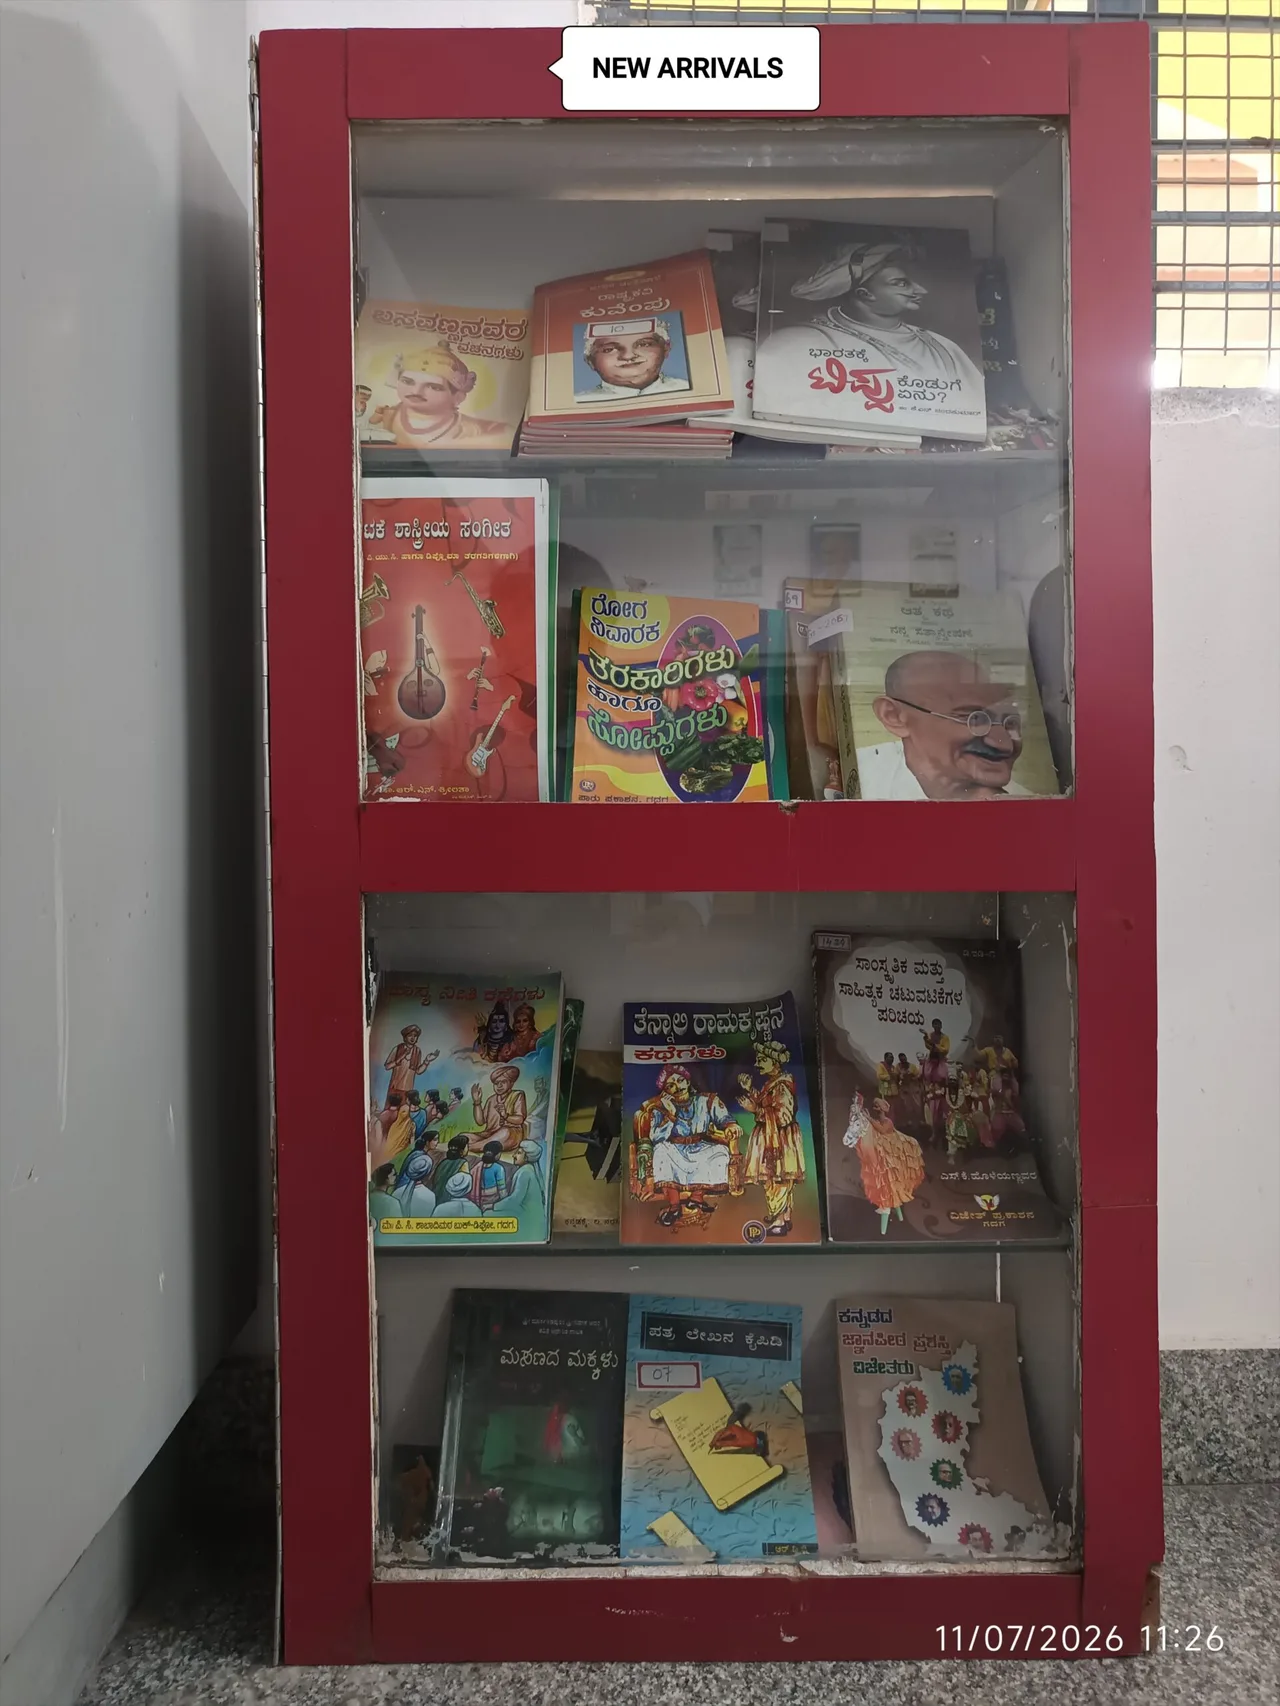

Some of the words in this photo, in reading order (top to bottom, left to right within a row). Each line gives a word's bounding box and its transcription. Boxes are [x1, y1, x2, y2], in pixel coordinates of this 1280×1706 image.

[581, 297, 670, 317] ಕುವೆಂಪು
[372, 309, 528, 344] ಬಸವಣ್ಣನವರ
[457, 341, 524, 361] ವಚನಗಳು
[808, 348, 869, 362] ಭಾರತಕ್ಕೆ
[808, 357, 897, 413] ಟಿಪ್ಪು
[897, 375, 962, 391] ಕೊಡುಗೆ
[897, 389, 947, 403] ಏನು?
[395, 517, 450, 549] ಶಾಸ್ತ್ರೀಯ
[460, 517, 511, 538] ಸಂಗೀತ
[591, 593, 648, 619] ರೋಗ
[590, 616, 661, 643] ನಿವಾರಕ
[589, 645, 735, 691] ತರಕಾರಿಗಳು
[586, 677, 663, 712] ಹಾಗೂ
[856, 956, 908, 985] ಸಾಂಸ್ಕೃತಿಕ
[914, 958, 945, 984] ಮತ್ತು
[838, 981, 883, 1008] ಸಾಹಿತ್ಯಕ
[889, 985, 963, 1006] ಚಟುವಟಿಕೆಗಳ
[633, 1006, 689, 1044] ತೆನ್ನಾಲಿ
[693, 999, 785, 1041] ರಾಮಕೃಷ್ಣನ
[877, 1007, 925, 1026] ಪರಿಚಯ
[838, 1307, 893, 1329] ಕನ್ನಡದ
[649, 1325, 676, 1341] ಪತ್ರ
[686, 1328, 734, 1343] ಲೇಖನ
[745, 1332, 783, 1351] ಕೈಪಿಡಿ
[500, 1347, 560, 1367] ಮಸಣದ
[567, 1350, 619, 1381] ಮಕ್ಕಳು
[652, 1365, 672, 1383] 07
[852, 1357, 915, 1376] ವಿಜೇತರು
